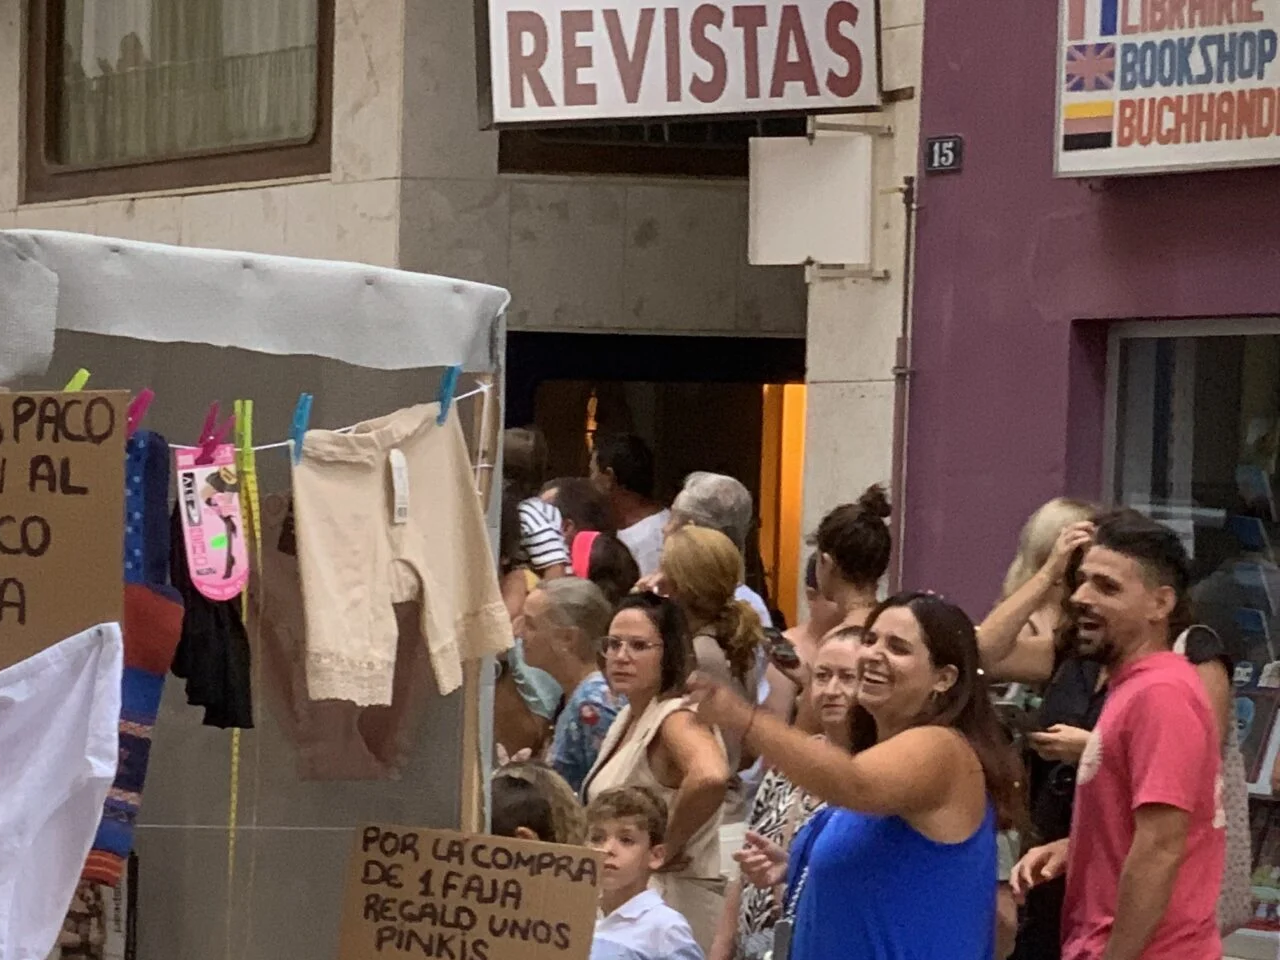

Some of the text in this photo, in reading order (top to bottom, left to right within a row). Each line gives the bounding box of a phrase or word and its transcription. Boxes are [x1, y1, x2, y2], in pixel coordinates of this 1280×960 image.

[506, 0, 863, 108] REVISTAS
[1120, 29, 1277, 91] BOOKSHOP
[1117, 87, 1280, 147] BUCHHAND
[932, 141, 954, 167] 15
[12, 396, 115, 445] PACO
[28, 454, 89, 495] AL
[361, 860, 523, 910] DE 1 FAJA
[362, 826, 597, 887] POR LA COMPRA
[363, 893, 570, 950] REGALO UNOS
